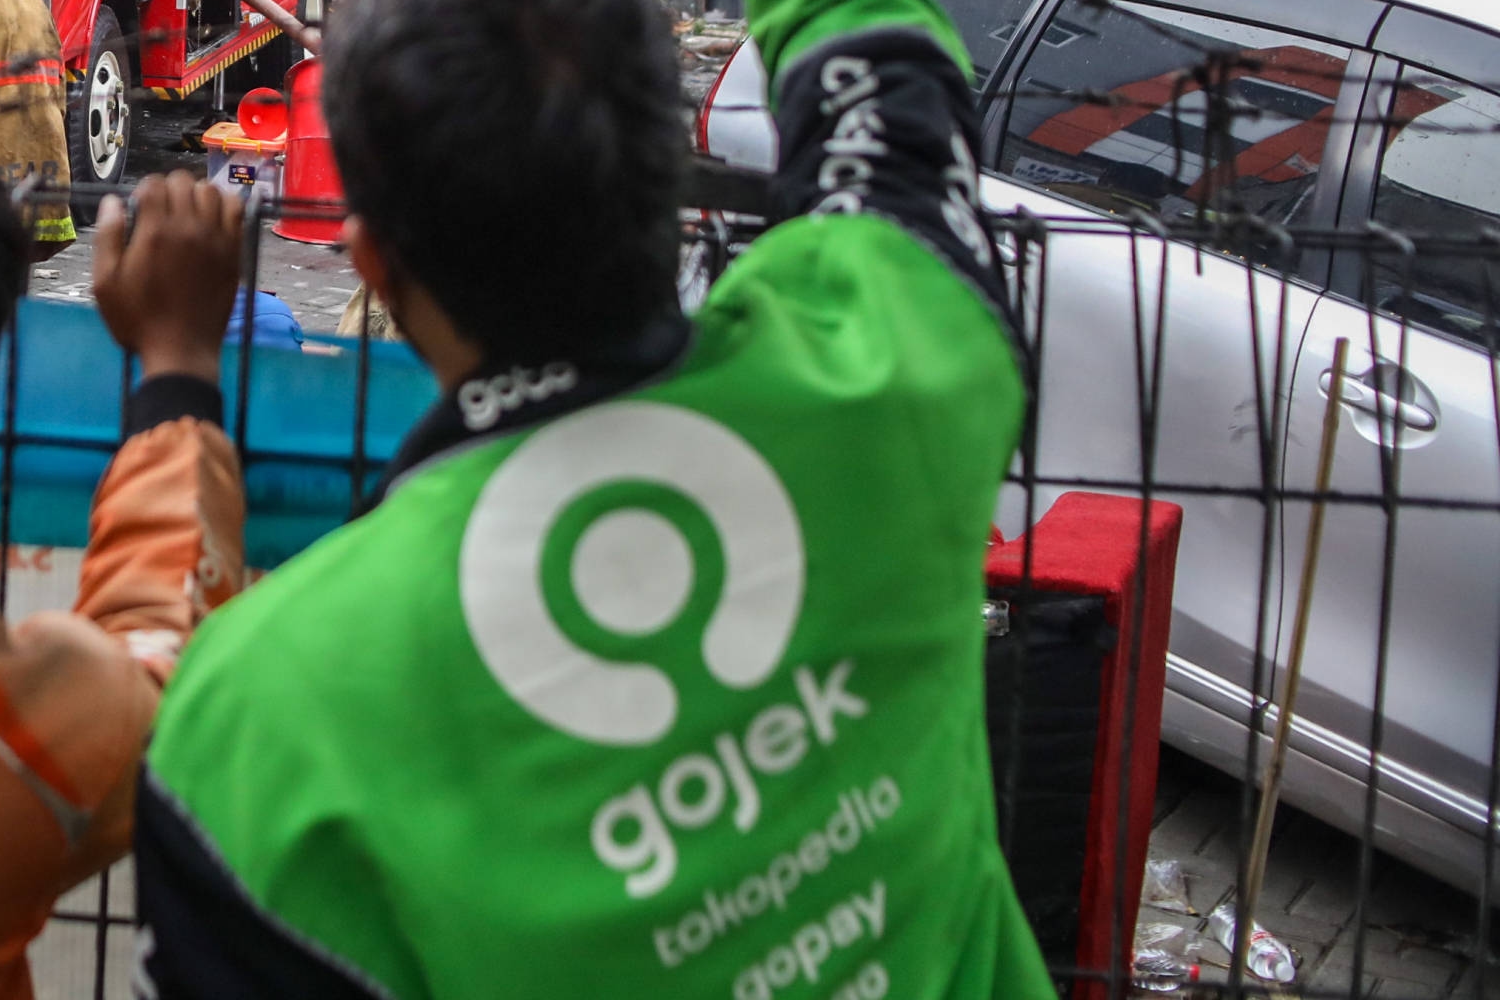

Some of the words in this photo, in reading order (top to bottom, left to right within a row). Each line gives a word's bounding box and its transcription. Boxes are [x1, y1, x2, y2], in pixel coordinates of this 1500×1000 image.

[590, 658, 869, 899] gojek
[653, 775, 901, 968] tokopedia
[732, 879, 888, 1000] gopay
